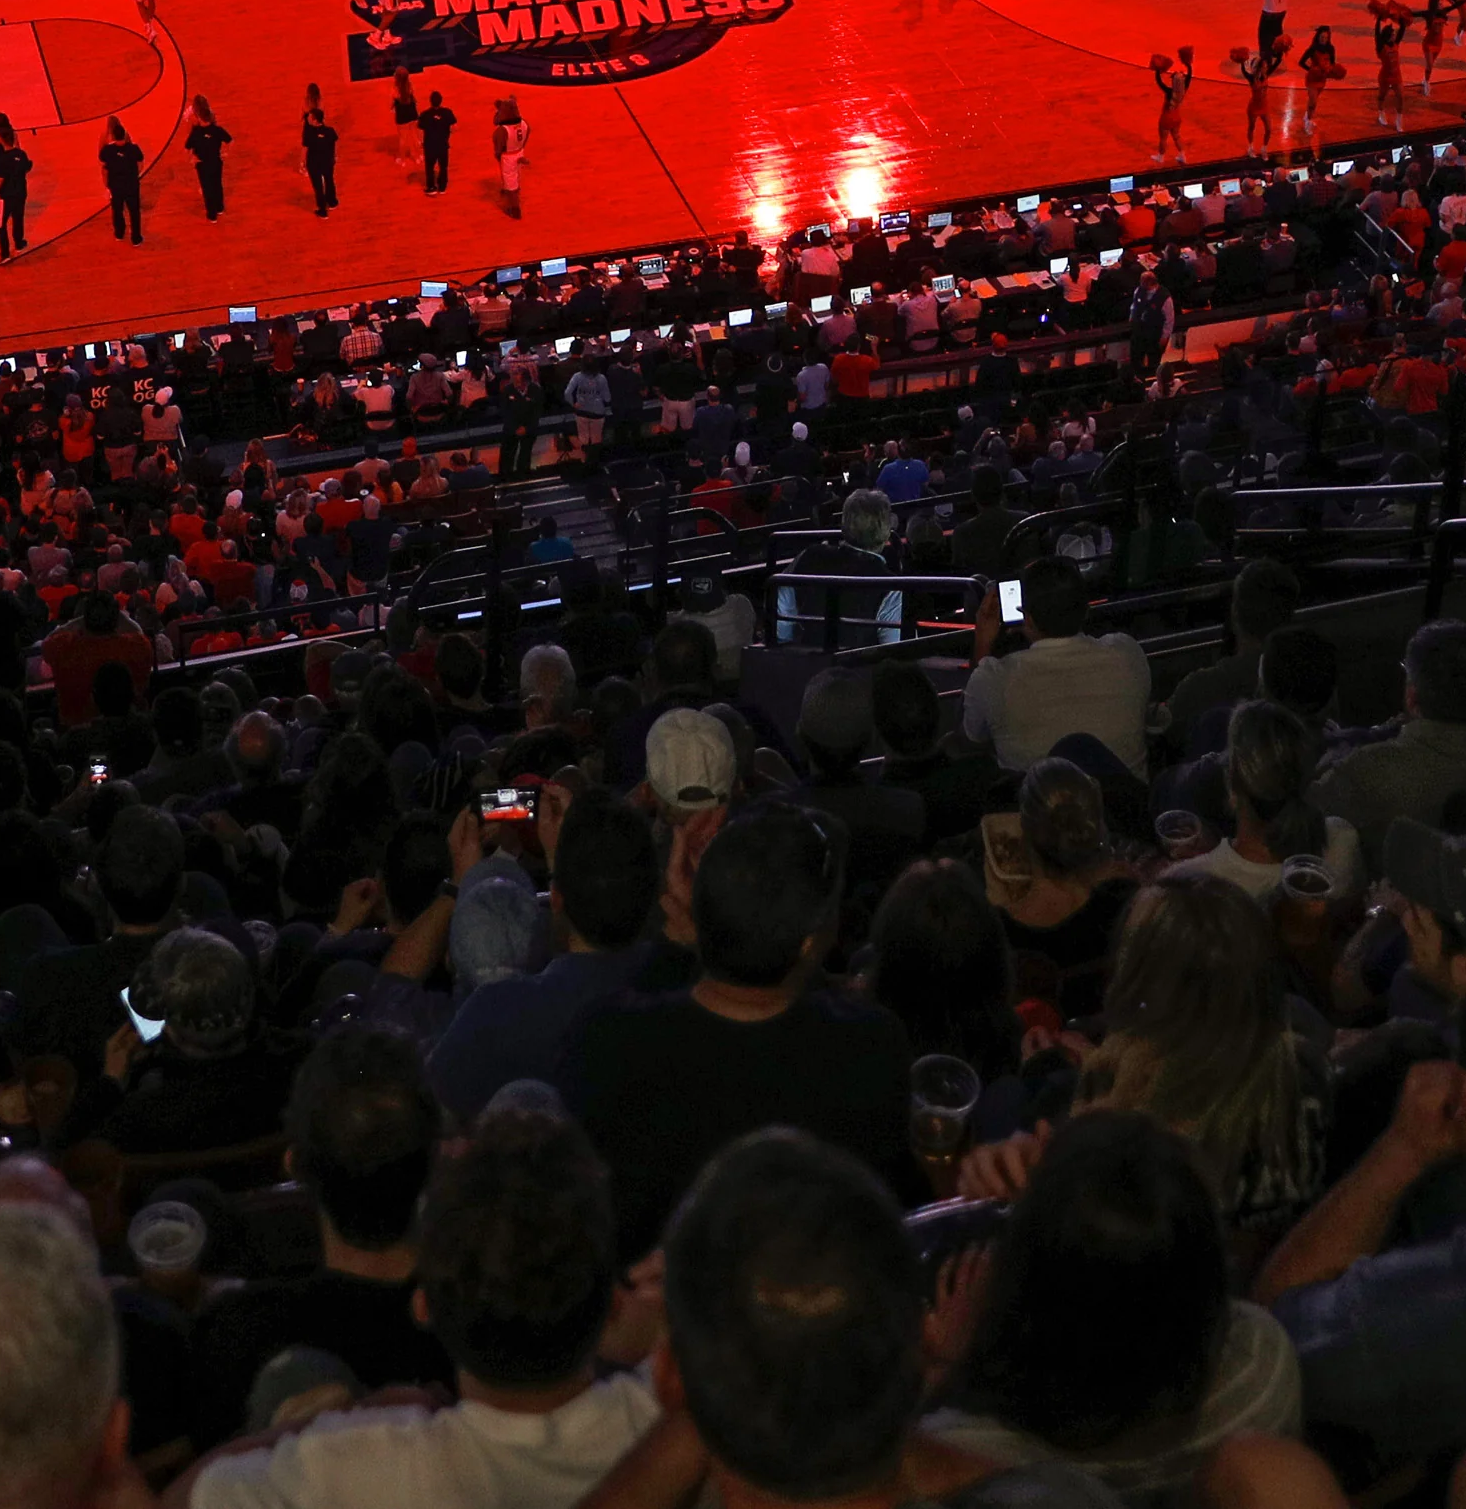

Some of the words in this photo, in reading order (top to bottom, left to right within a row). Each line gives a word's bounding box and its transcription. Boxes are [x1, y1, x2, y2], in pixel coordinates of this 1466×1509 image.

[551, 58, 629, 77] ELITE
[634, 52, 650, 67] 8
[91, 385, 111, 399] KC
[134, 377, 154, 392] KC
